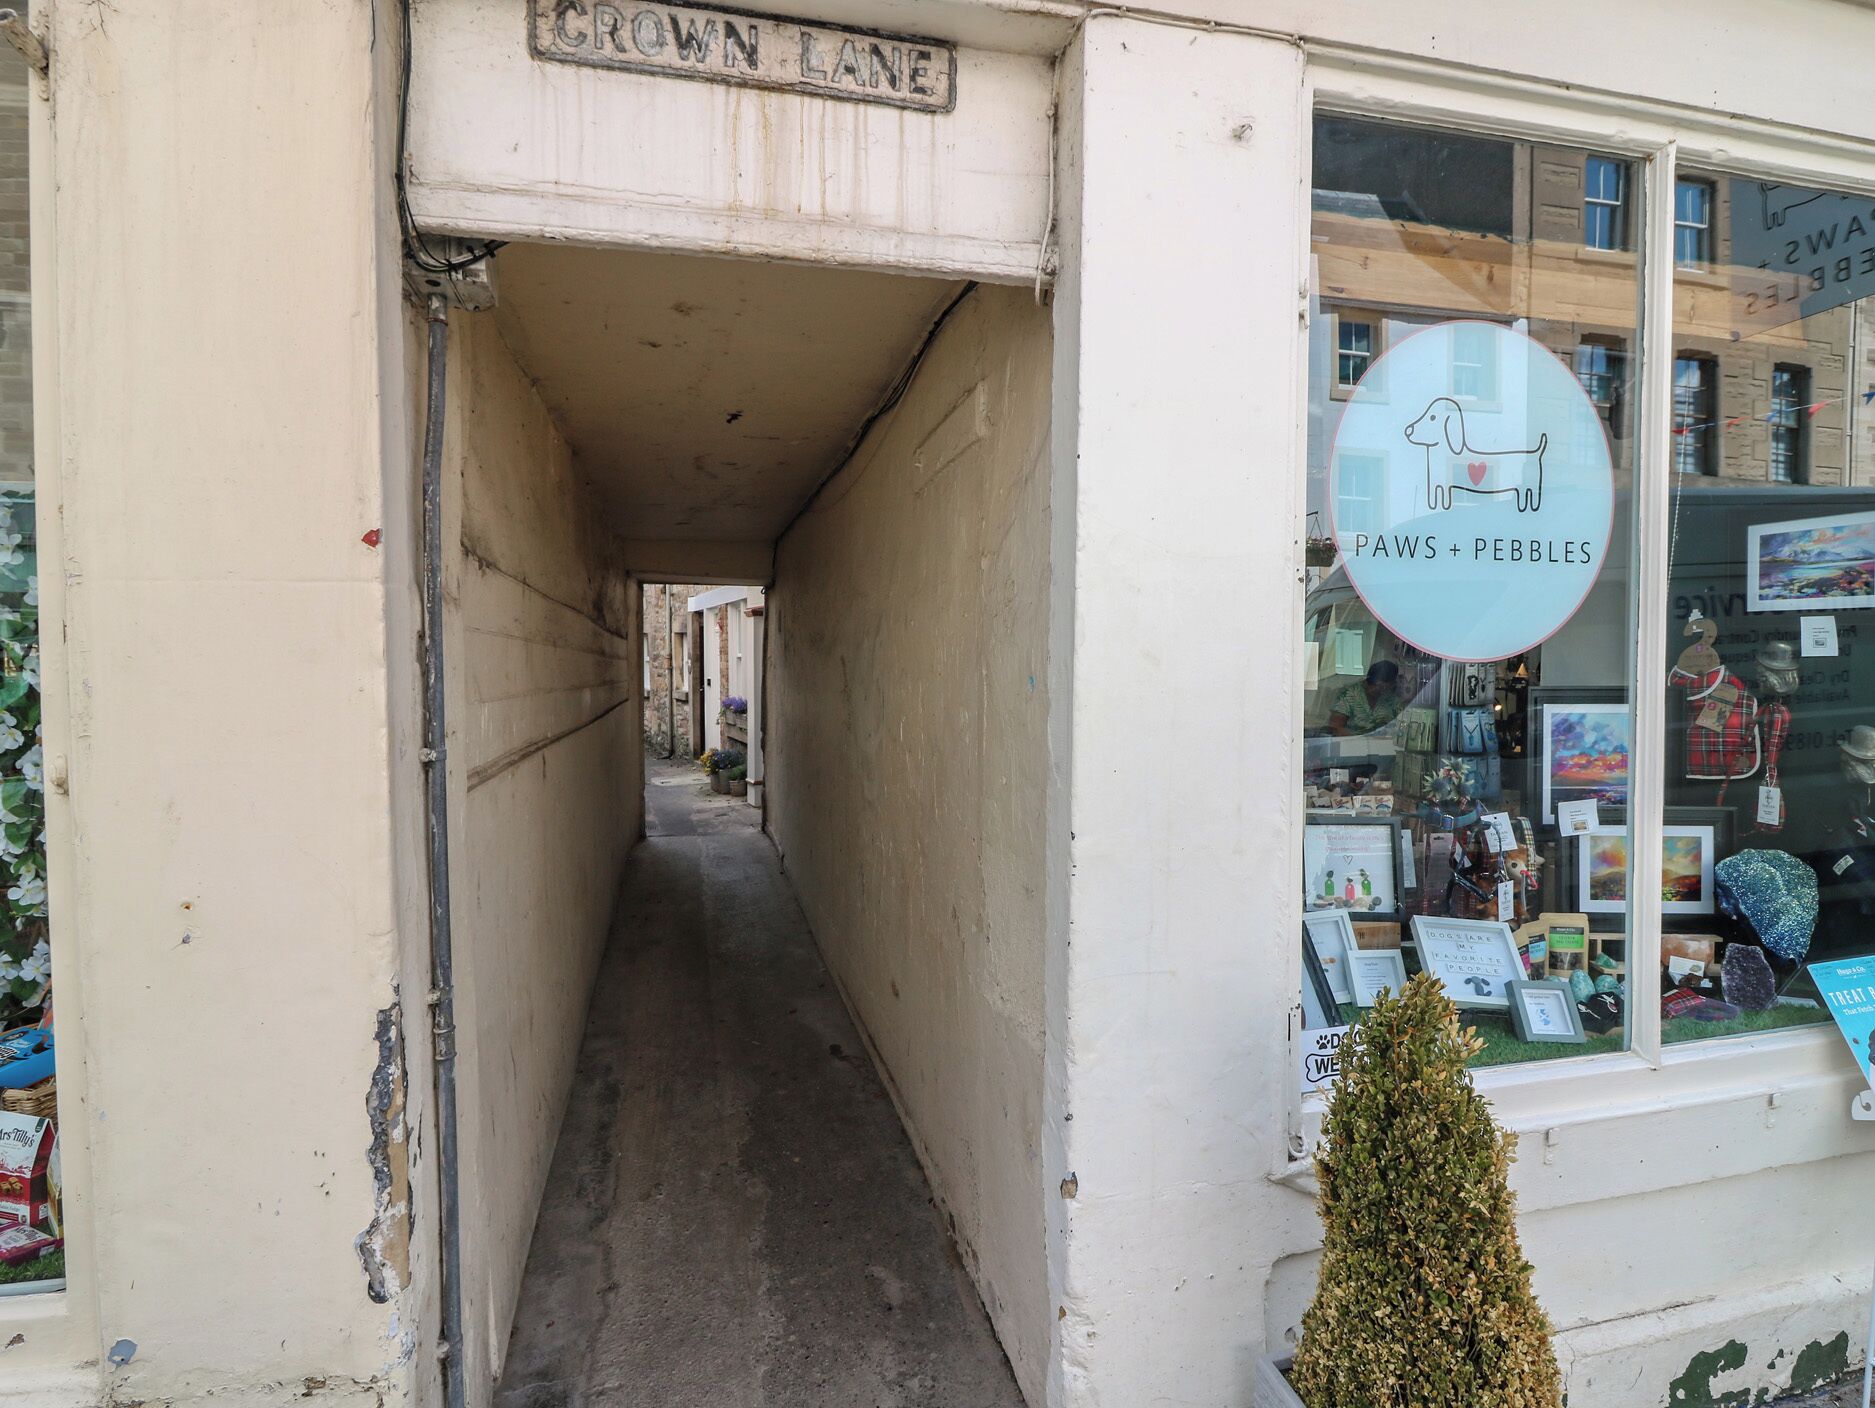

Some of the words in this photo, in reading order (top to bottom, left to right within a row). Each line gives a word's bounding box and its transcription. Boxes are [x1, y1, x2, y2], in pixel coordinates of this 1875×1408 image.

[556, 0, 759, 71] CROWN
[801, 31, 934, 95] LANE
[1355, 533, 1437, 560] PAWS
[1474, 538, 1592, 565] PEBBLES
[1828, 987, 1867, 1007] TREAT
[12, 1127, 35, 1148] Tilly's
